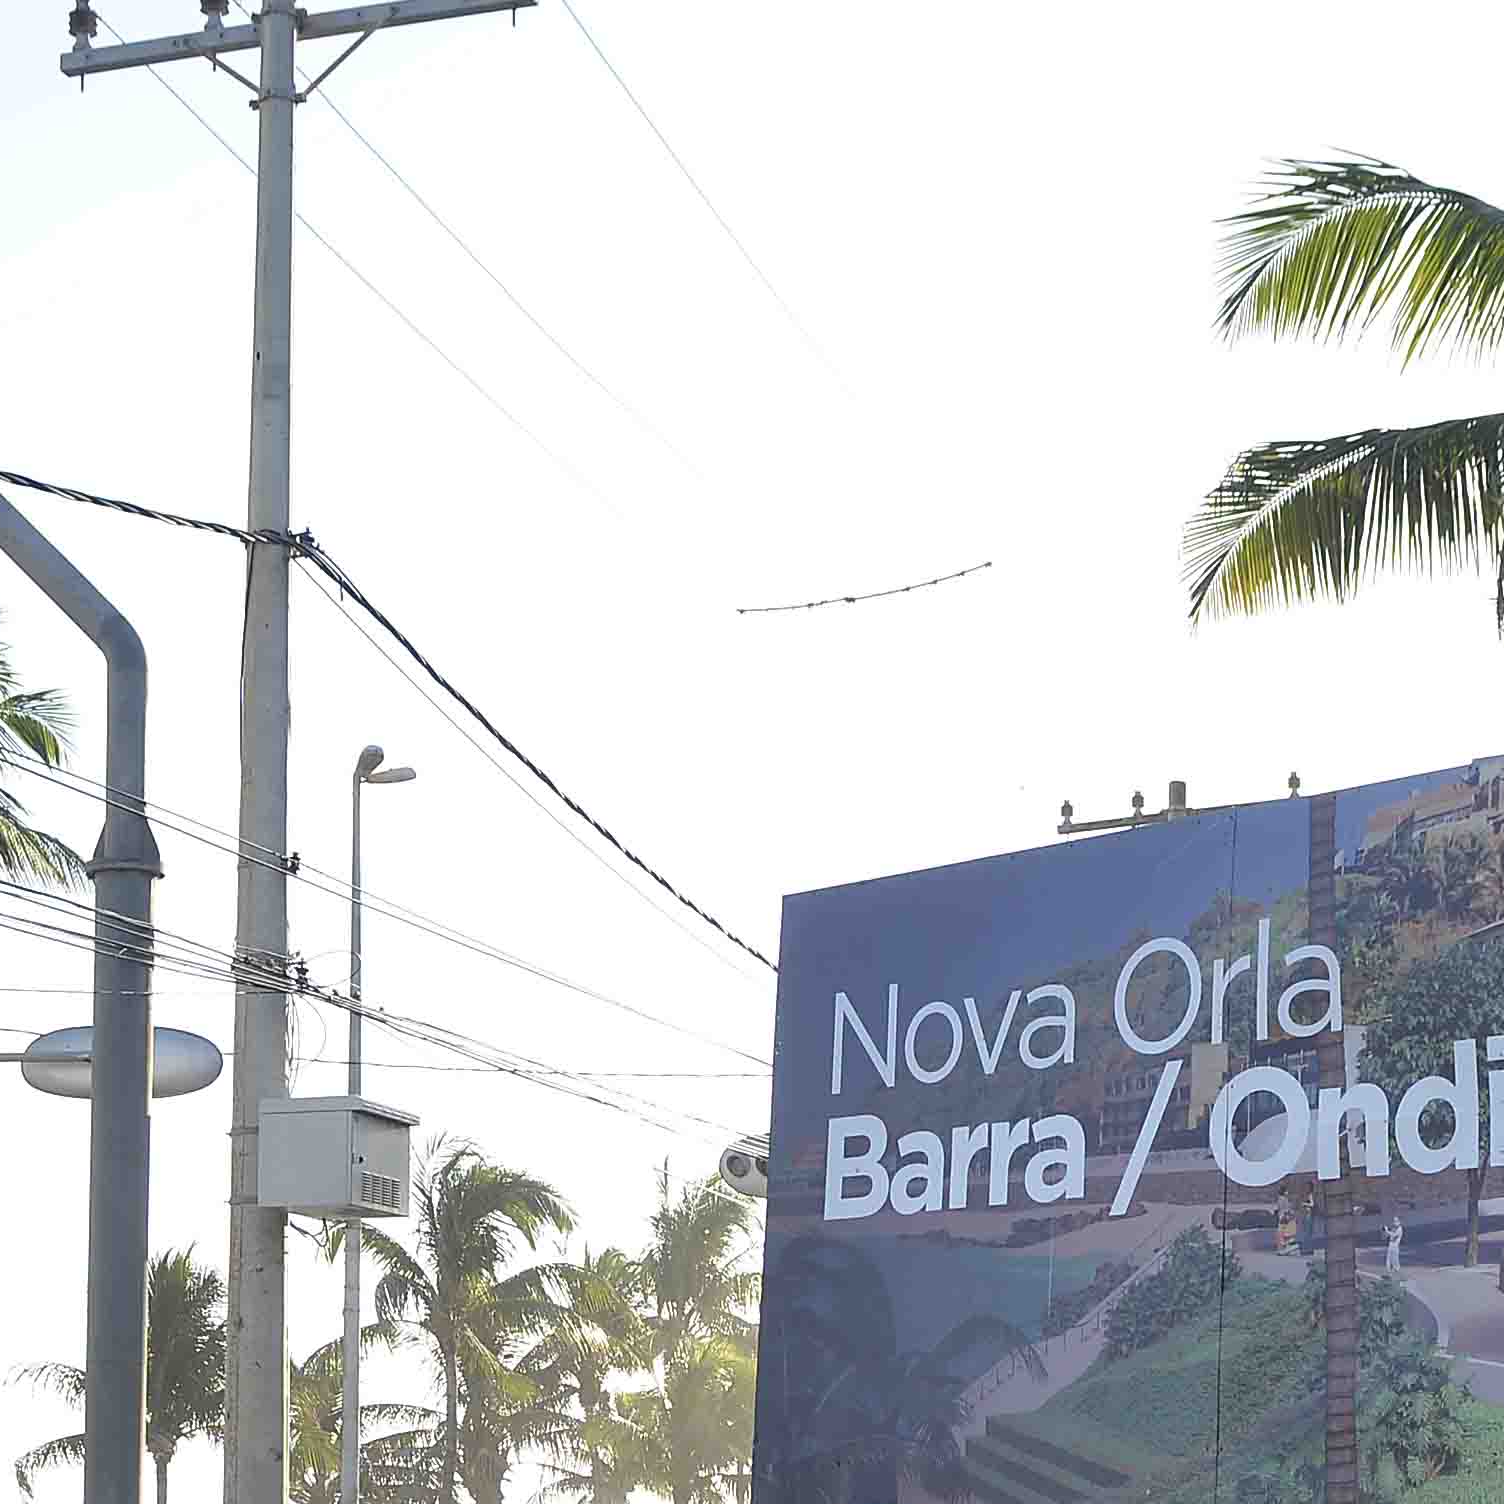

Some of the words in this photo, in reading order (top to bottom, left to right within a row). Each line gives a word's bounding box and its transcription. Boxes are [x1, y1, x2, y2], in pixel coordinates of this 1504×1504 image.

[829, 983, 1076, 1095] Nova
[1112, 917, 1345, 1056] Orla
[822, 1113, 1087, 1222] Barra
[1109, 1058, 1184, 1217] /
